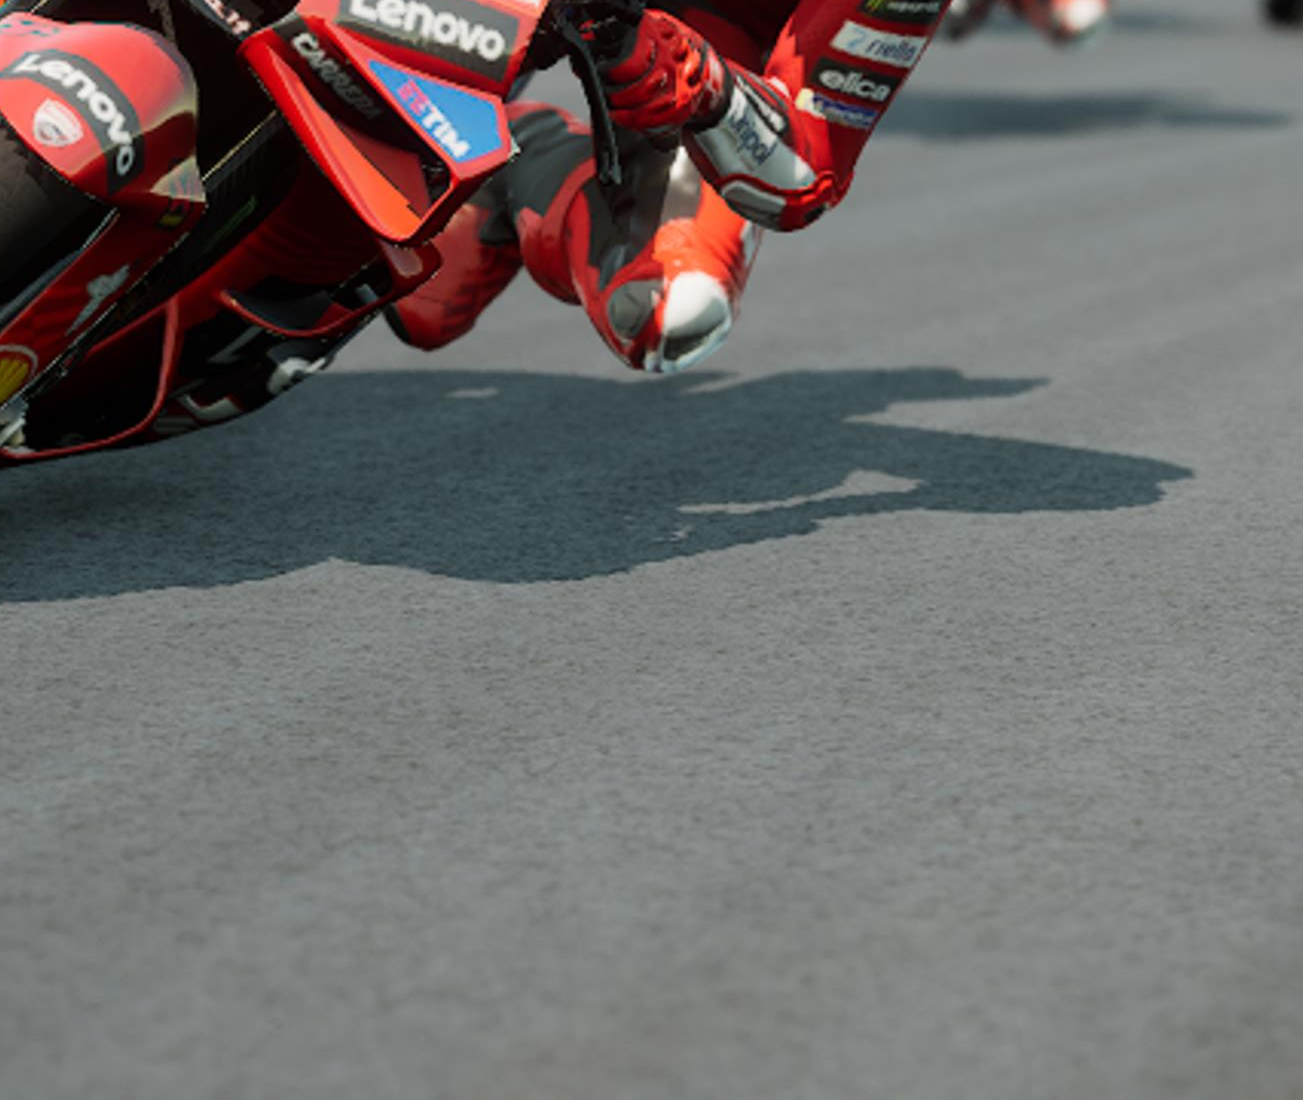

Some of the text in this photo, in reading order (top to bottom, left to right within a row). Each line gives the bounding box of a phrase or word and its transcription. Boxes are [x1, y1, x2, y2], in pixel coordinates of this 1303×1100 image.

[818, 68, 892, 103] elica
[13, 51, 135, 177] Lenovo
[421, 104, 472, 159] TIM
